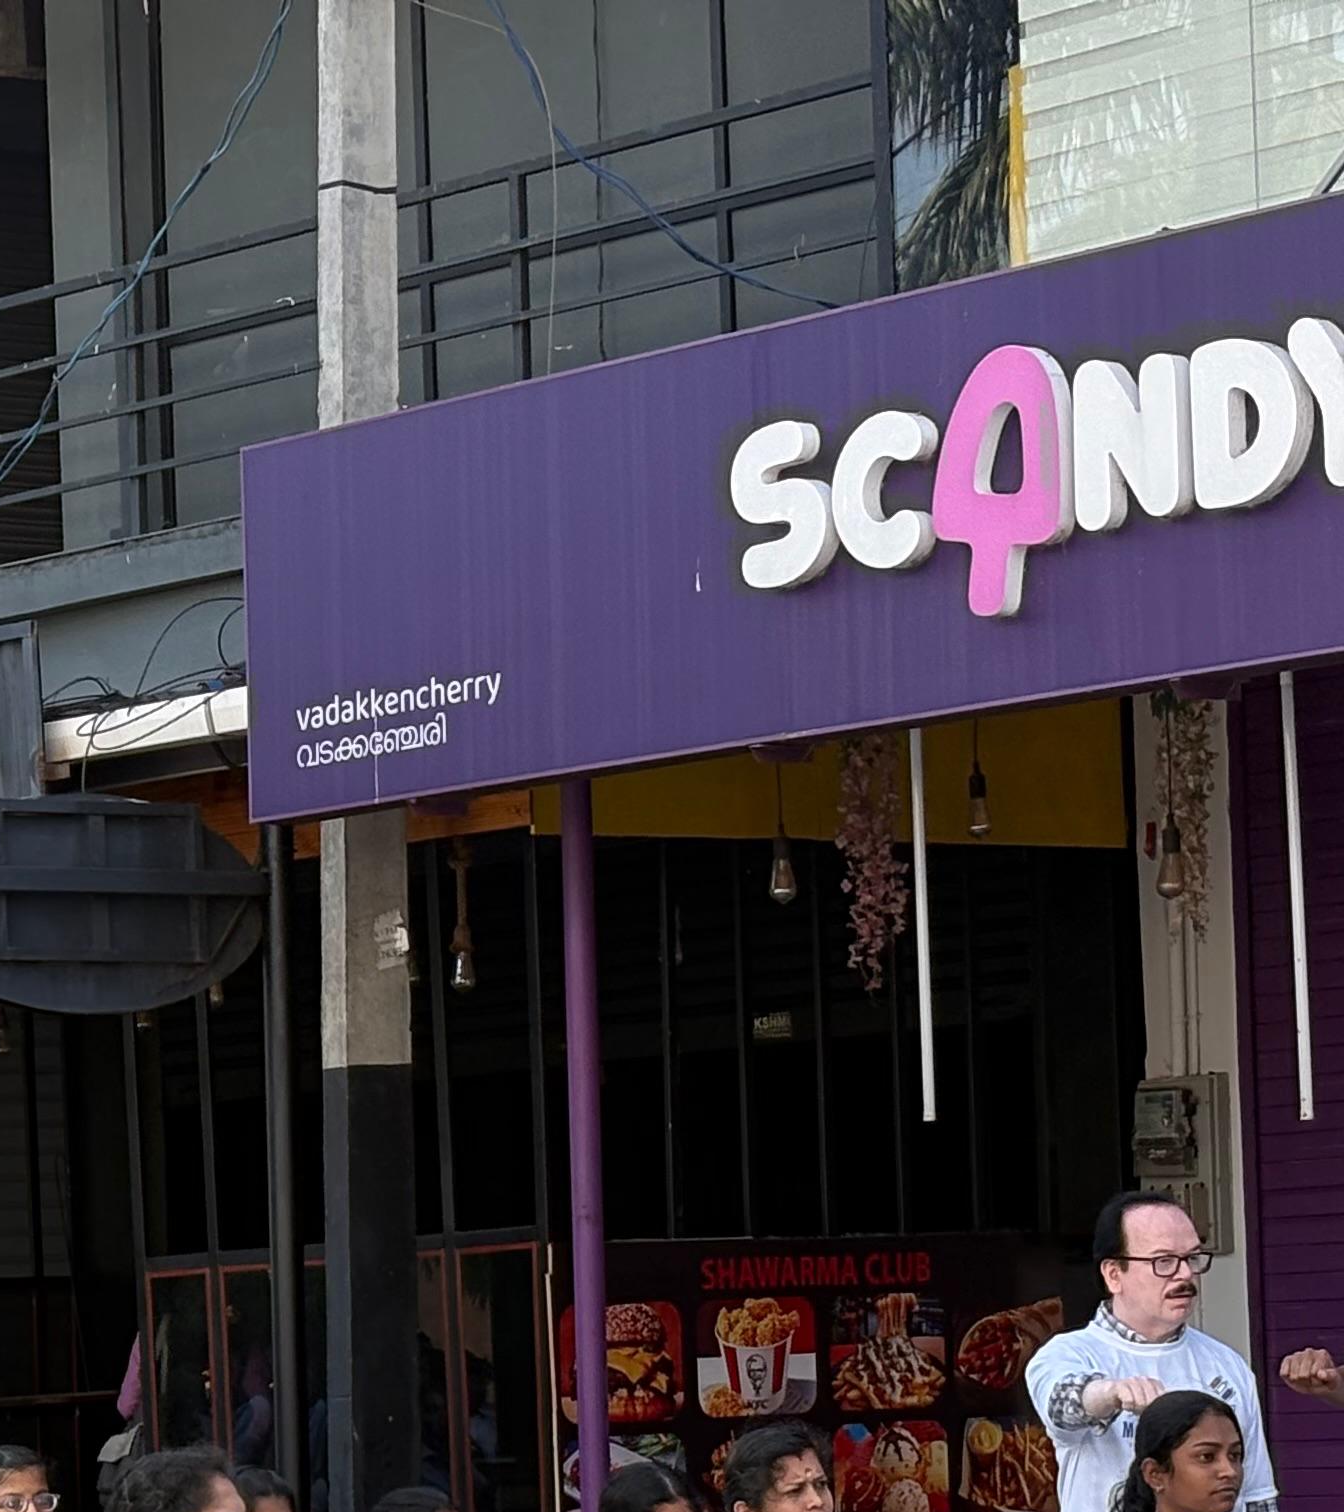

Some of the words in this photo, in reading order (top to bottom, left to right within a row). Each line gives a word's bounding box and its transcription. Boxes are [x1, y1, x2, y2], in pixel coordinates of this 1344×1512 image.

[296, 672, 502, 731] vadakkencherry
[700, 1256, 859, 1291] SHAWARMA
[864, 1251, 932, 1286] CLUB
